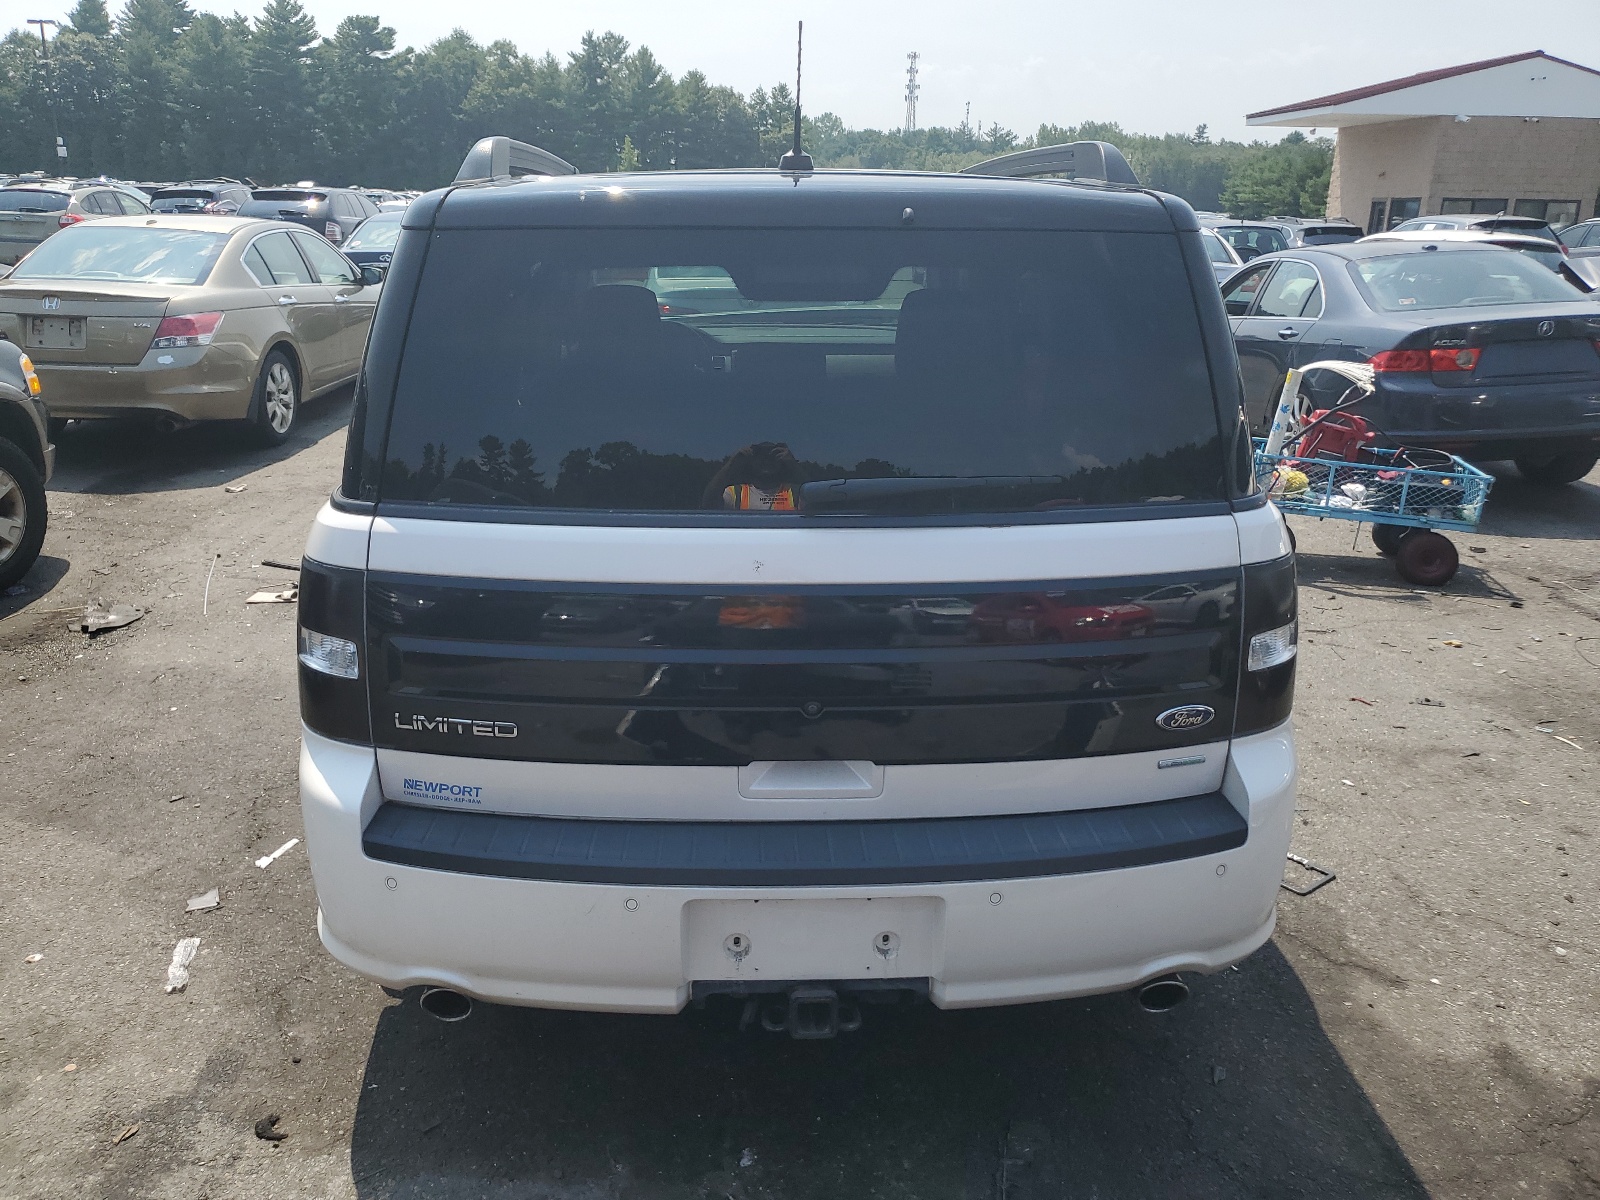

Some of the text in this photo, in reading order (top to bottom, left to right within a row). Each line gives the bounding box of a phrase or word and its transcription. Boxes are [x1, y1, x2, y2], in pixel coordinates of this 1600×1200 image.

[394, 712, 518, 738] LIMITED
[1170, 711, 1204, 727] Ford
[403, 778, 482, 798] NEWPORT
